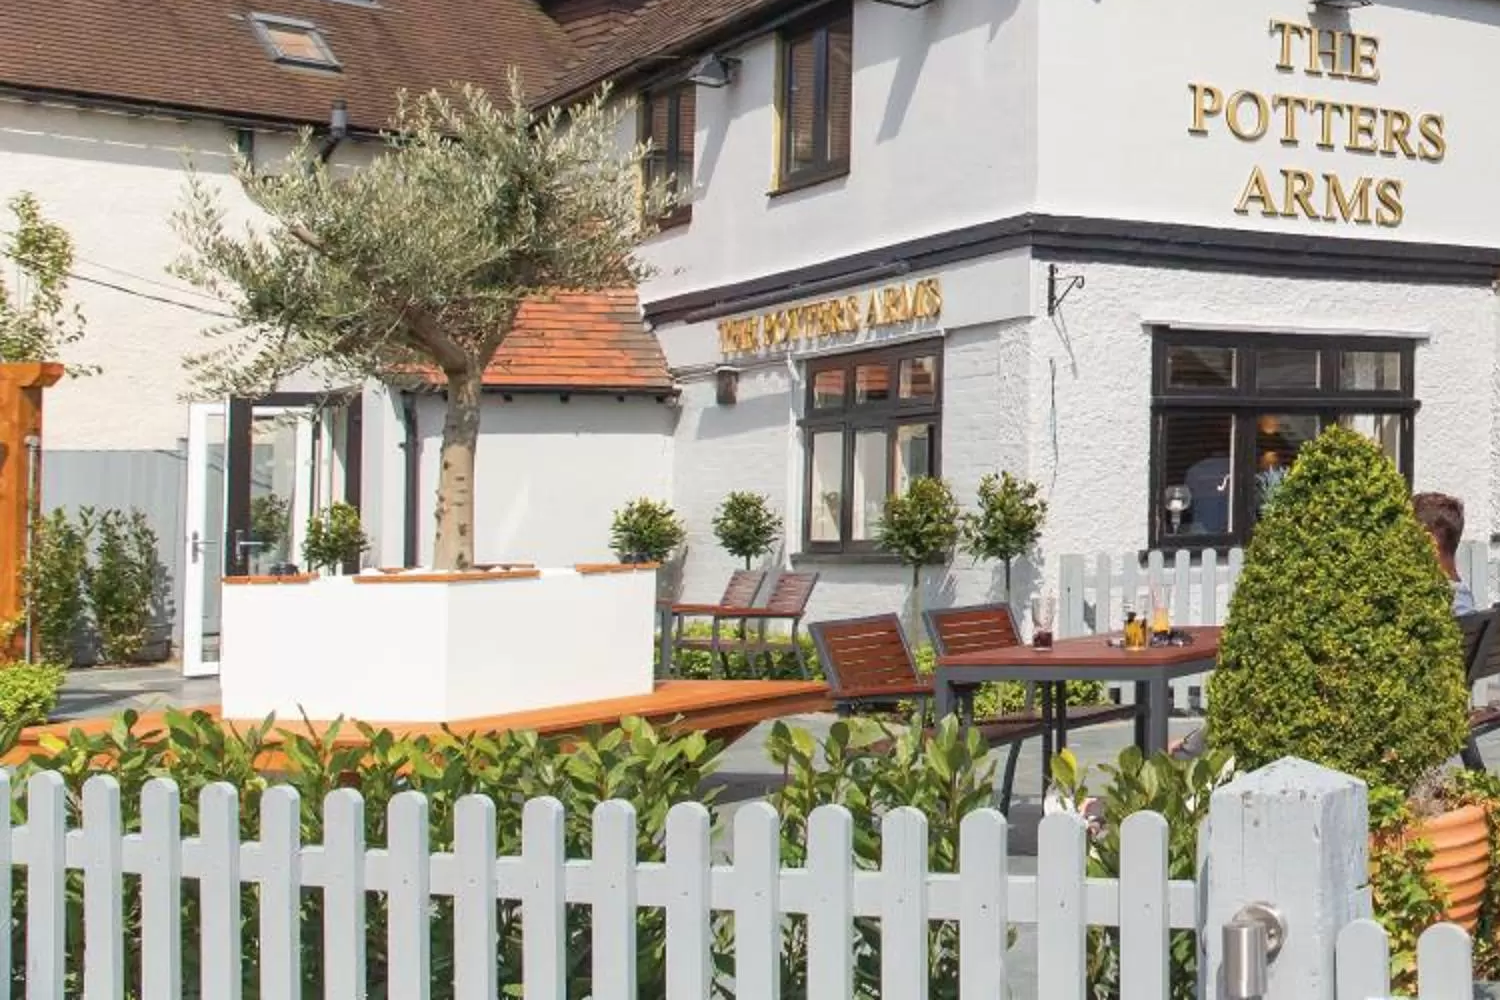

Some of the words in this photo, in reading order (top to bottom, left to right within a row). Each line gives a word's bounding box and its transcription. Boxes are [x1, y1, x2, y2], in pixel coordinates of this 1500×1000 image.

[1269, 18, 1381, 84] THE
[1187, 83, 1447, 162] POTTERS
[1233, 165, 1404, 228] ARMS
[864, 279, 943, 329] ARMS
